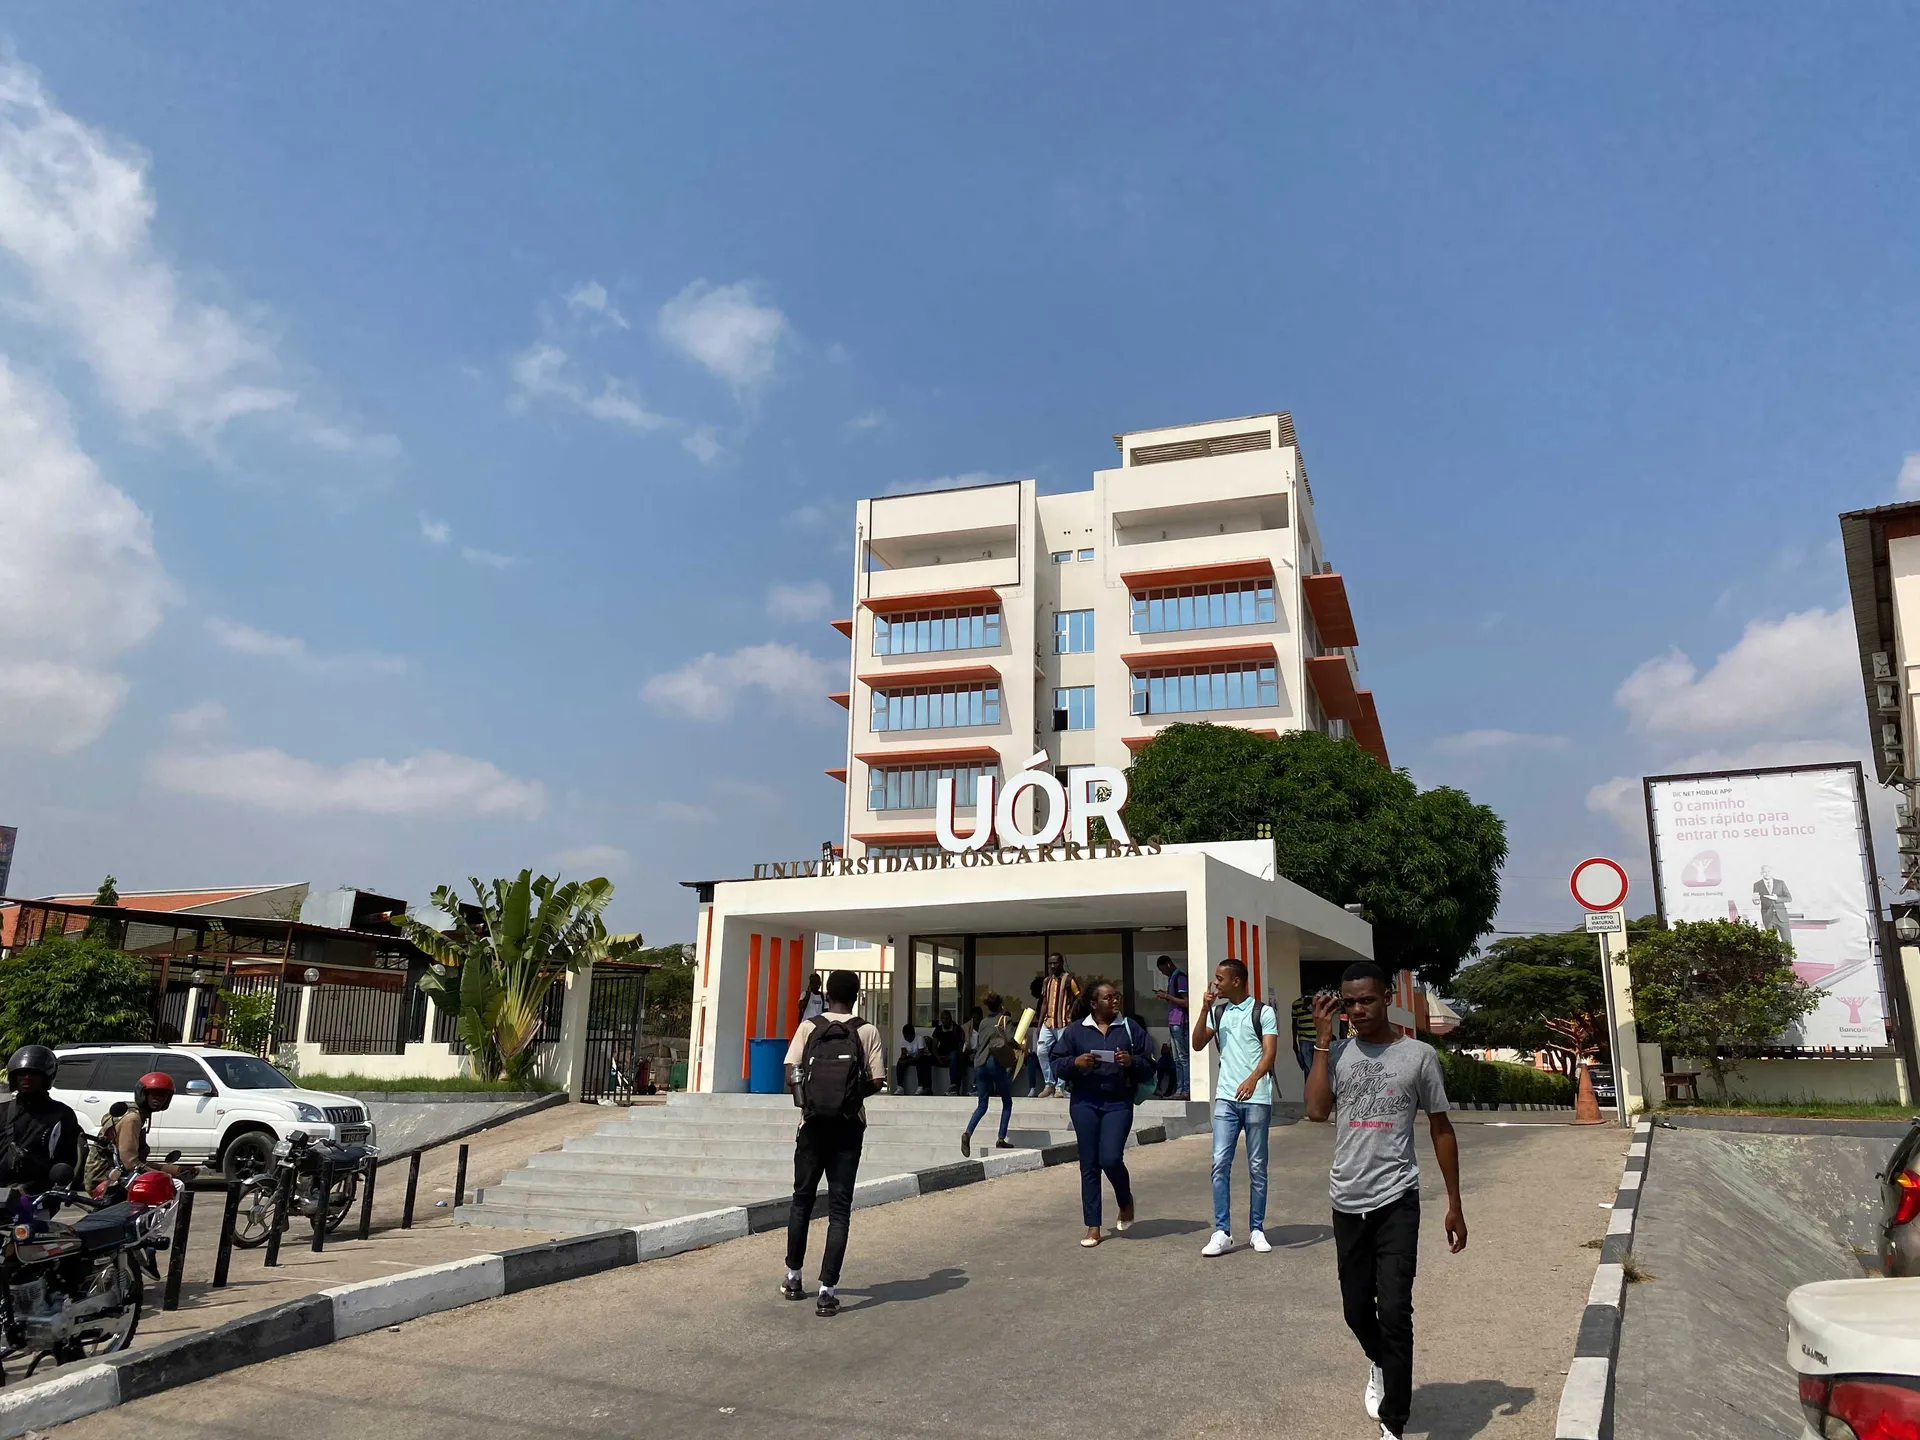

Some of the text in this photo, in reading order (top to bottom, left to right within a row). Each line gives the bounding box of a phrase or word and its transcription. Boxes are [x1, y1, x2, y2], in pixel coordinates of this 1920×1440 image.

[936, 749, 1131, 850] UÓR
[1673, 798, 1745, 812] O caminho
[1675, 811, 1790, 827] mais rápido para
[1676, 824, 1816, 841] entrar no seu banco
[753, 851, 955, 881] UNIVERSIDADE
[1064, 834, 1161, 862] RIBAS
[1351, 1059, 1385, 1079] The
